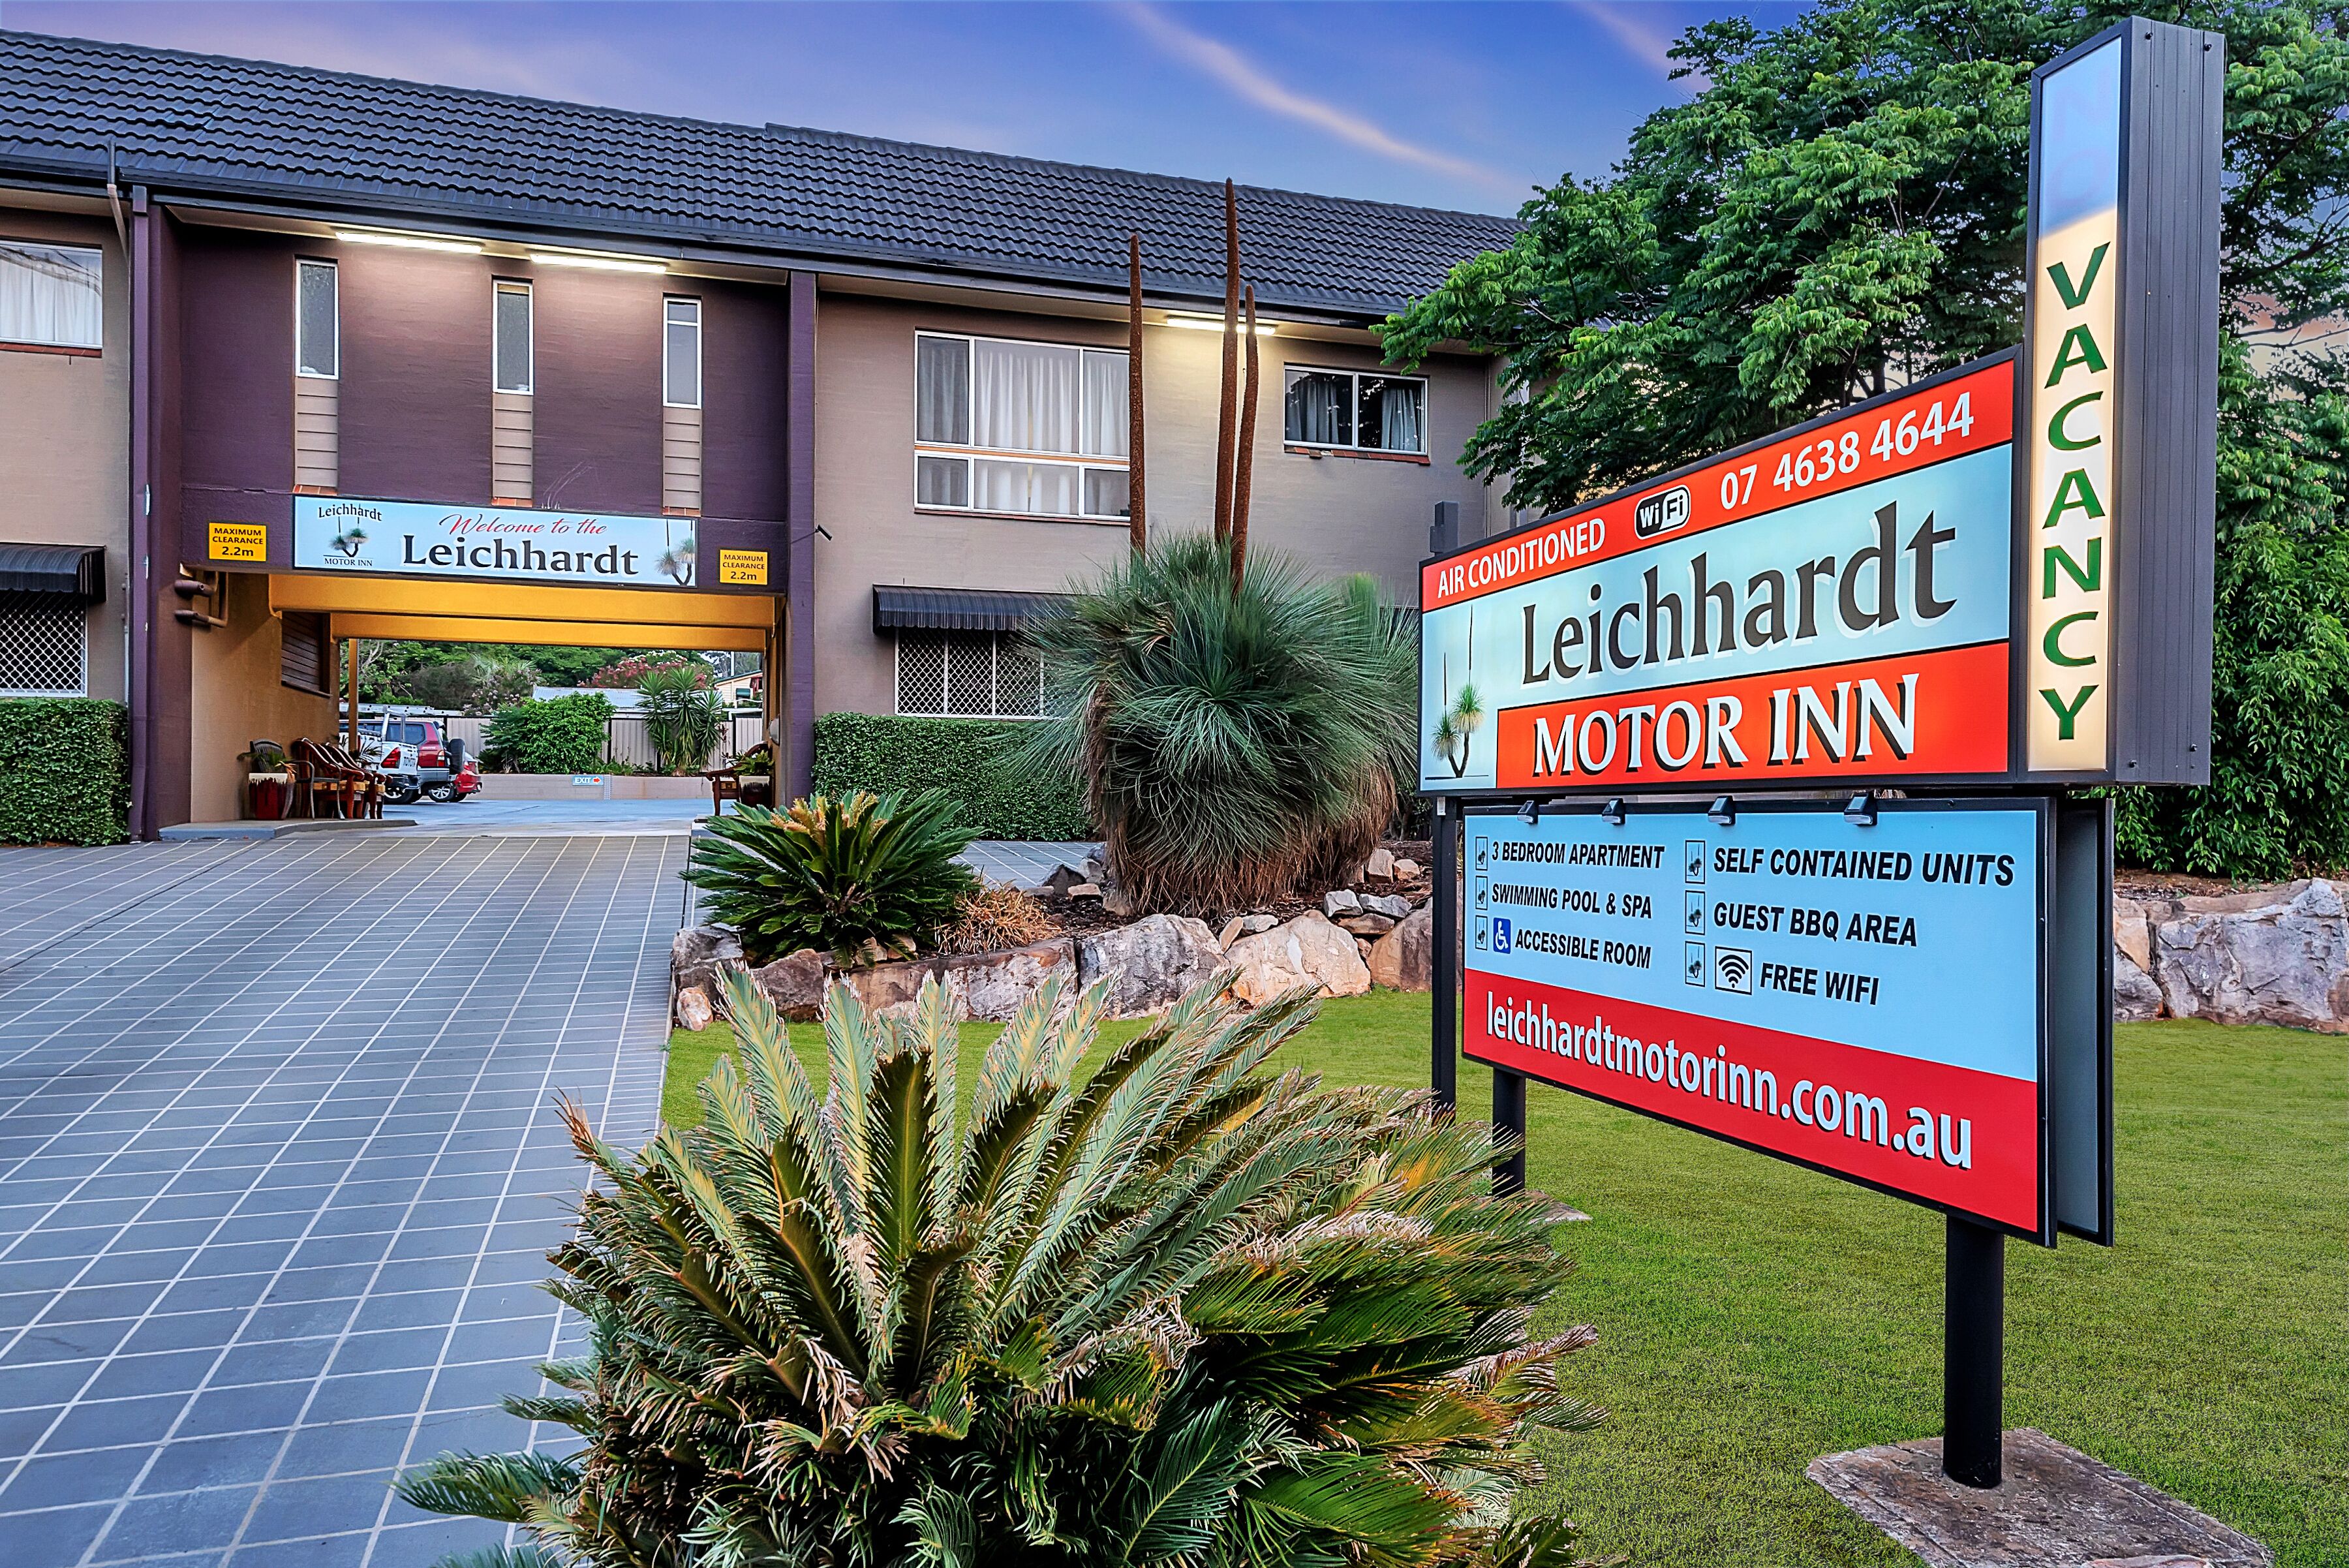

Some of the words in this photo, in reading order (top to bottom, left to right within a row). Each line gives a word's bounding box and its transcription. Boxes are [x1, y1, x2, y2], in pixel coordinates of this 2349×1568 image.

[1721, 464, 1758, 510] 07
[1773, 431, 1860, 492] 4638
[1870, 392, 1974, 462] 4644
[2038, 240, 2111, 741] VACANCY
[214, 527, 262, 536] MAXIMUM
[318, 503, 382, 521] Leichhardt
[438, 514, 545, 535] Welcome
[549, 520, 573, 534] to
[577, 519, 607, 534] the
[212, 536, 264, 545] CLEARANCE
[222, 546, 254, 557] 2.2m
[403, 534, 639, 575] Leichhardt
[1437, 567, 1465, 598] AIR
[1467, 518, 1606, 589] CONDITIONED
[730, 571, 757, 580] 2.2m
[1522, 501, 1956, 685] Leichhardt
[1533, 694, 1749, 777] MOTOR
[1771, 673, 1920, 766] INN
[1492, 841, 1499, 861] 3
[1502, 842, 1565, 864] BEDROOM
[1569, 844, 1665, 869] APARTMENT
[1713, 848, 1764, 873] SELF
[1770, 849, 1912, 881] CONTAINED
[1922, 853, 2015, 886] UNITS
[1492, 883, 1558, 908] SWIMMING
[1561, 889, 1600, 914] POOL
[1606, 893, 1616, 915] &
[1622, 894, 1651, 919] SPA
[1713, 902, 1785, 932] GUEST
[1790, 908, 1839, 942] BBQ
[1846, 914, 1918, 947] AREA
[1515, 929, 1599, 961] ACCESSIBLE
[1603, 942, 1651, 969] ROOM
[1760, 962, 1817, 995] FREE
[1825, 970, 1879, 1006] WIFI
[1486, 991, 1973, 1170] leichhardtmotorinn.com.au
